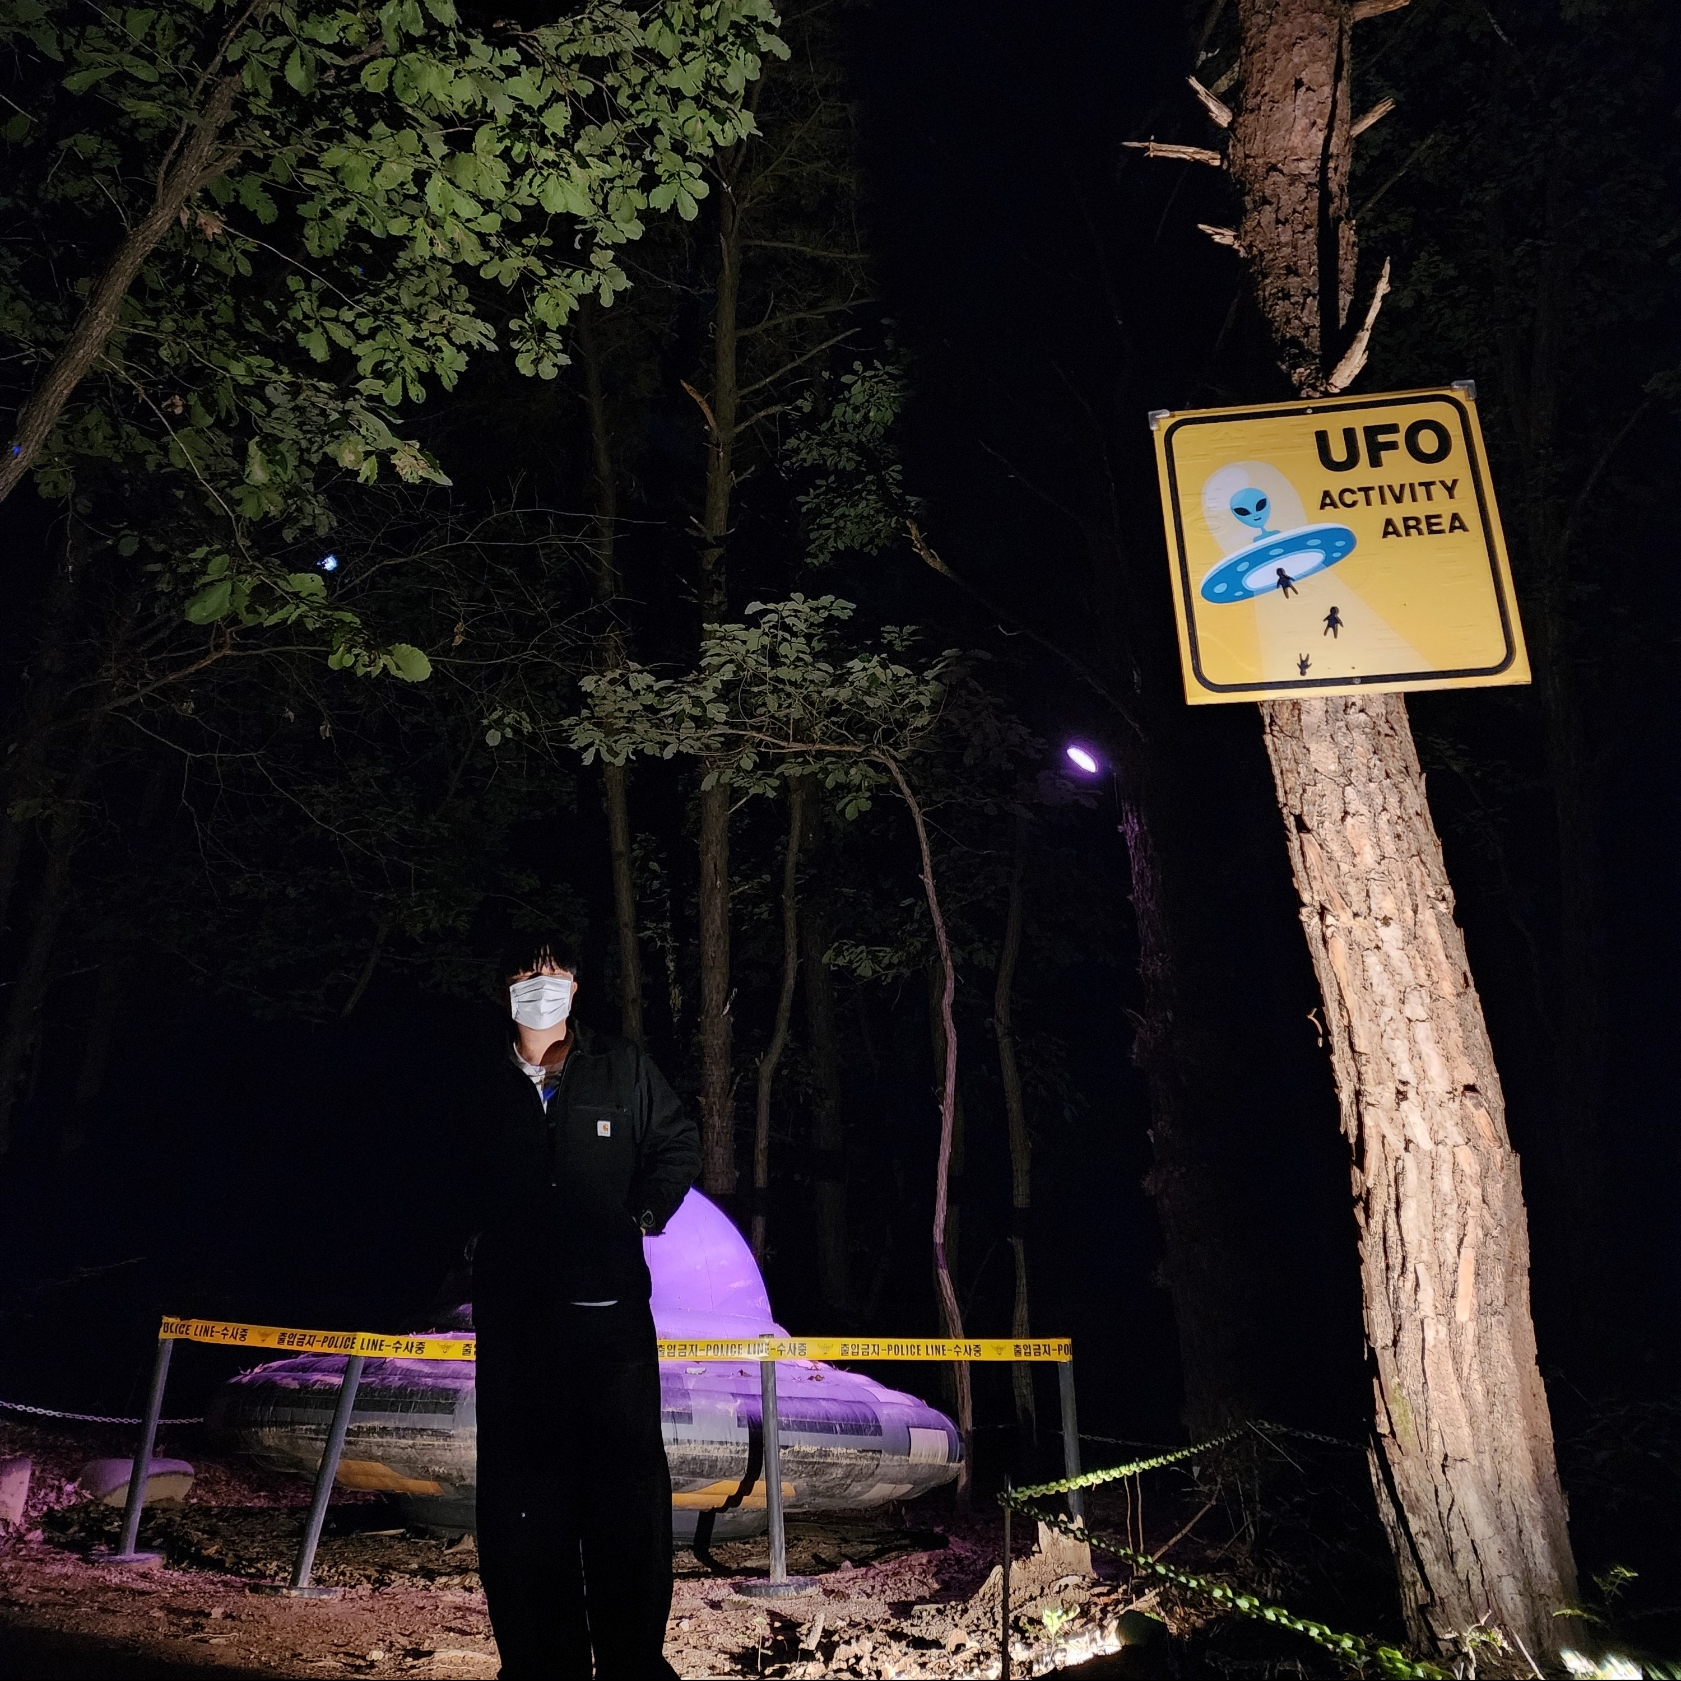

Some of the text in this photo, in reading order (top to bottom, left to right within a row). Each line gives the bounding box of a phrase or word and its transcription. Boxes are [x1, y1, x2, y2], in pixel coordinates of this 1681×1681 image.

[1315, 419, 1452, 472] UFO
[1319, 479, 1459, 510] ACTIVITY
[1382, 512, 1470, 539] AREA
